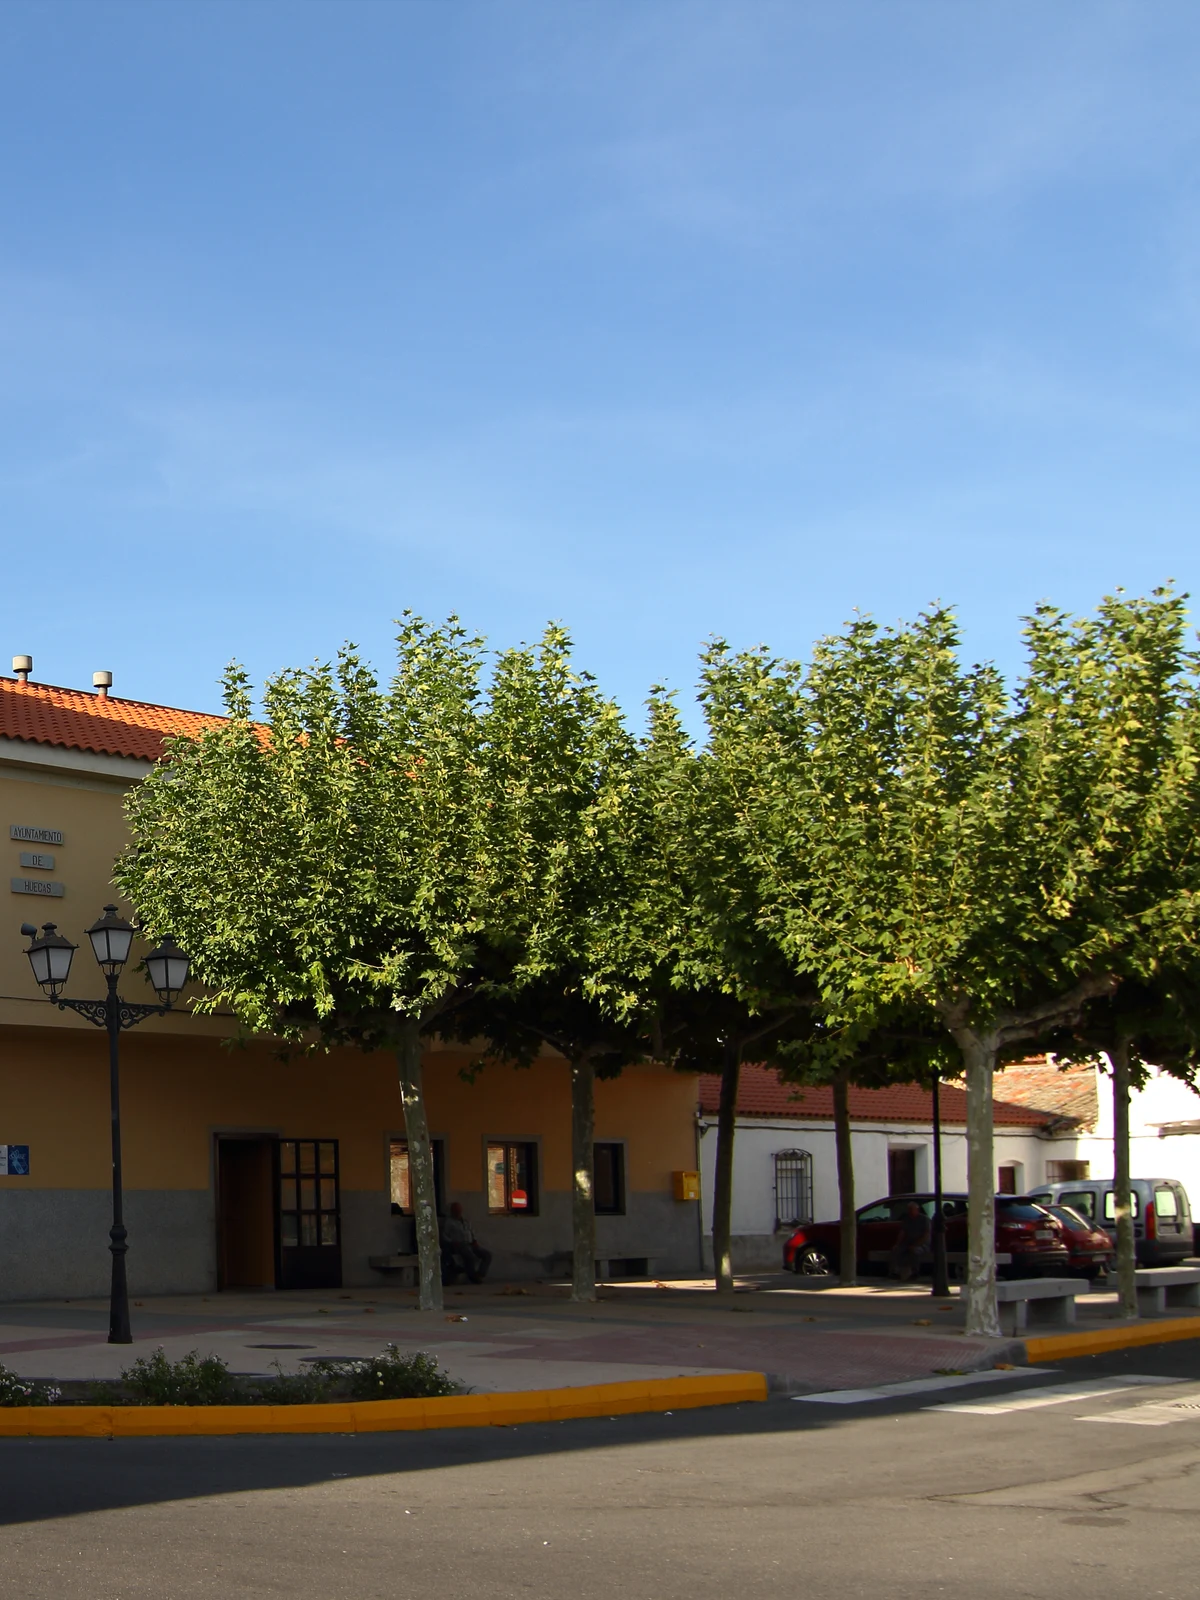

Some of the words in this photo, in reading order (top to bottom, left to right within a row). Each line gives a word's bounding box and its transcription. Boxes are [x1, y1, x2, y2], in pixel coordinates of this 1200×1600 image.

[13, 827, 62, 843] AYUNTAMIENTO
[32, 855, 43, 866] DE
[24, 881, 52, 894] HUECAS
